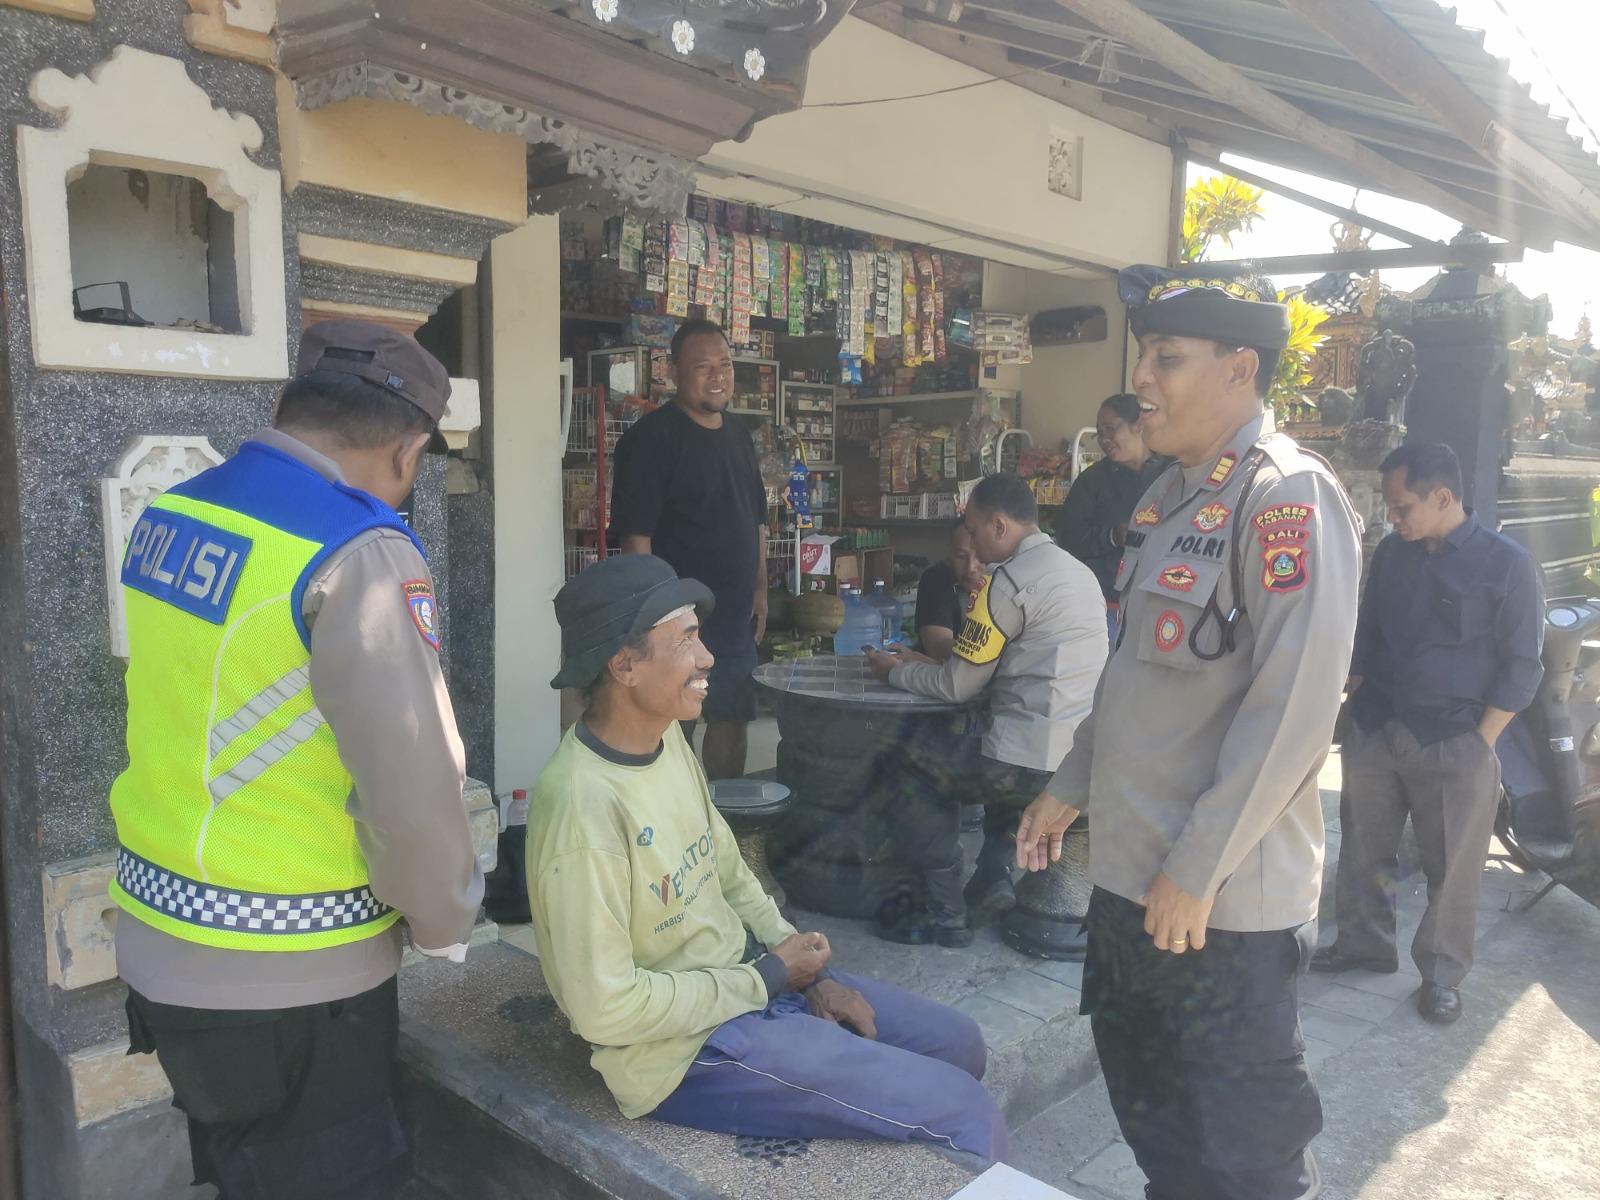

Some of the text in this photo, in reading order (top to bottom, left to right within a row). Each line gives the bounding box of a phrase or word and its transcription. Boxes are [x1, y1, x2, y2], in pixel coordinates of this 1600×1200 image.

[1256, 507, 1308, 524] POLRES
[1259, 514, 1304, 528] TABANAN
[1267, 530, 1299, 541] BALI
[1170, 535, 1226, 558] POLRI
[128, 518, 240, 606] POLISI
